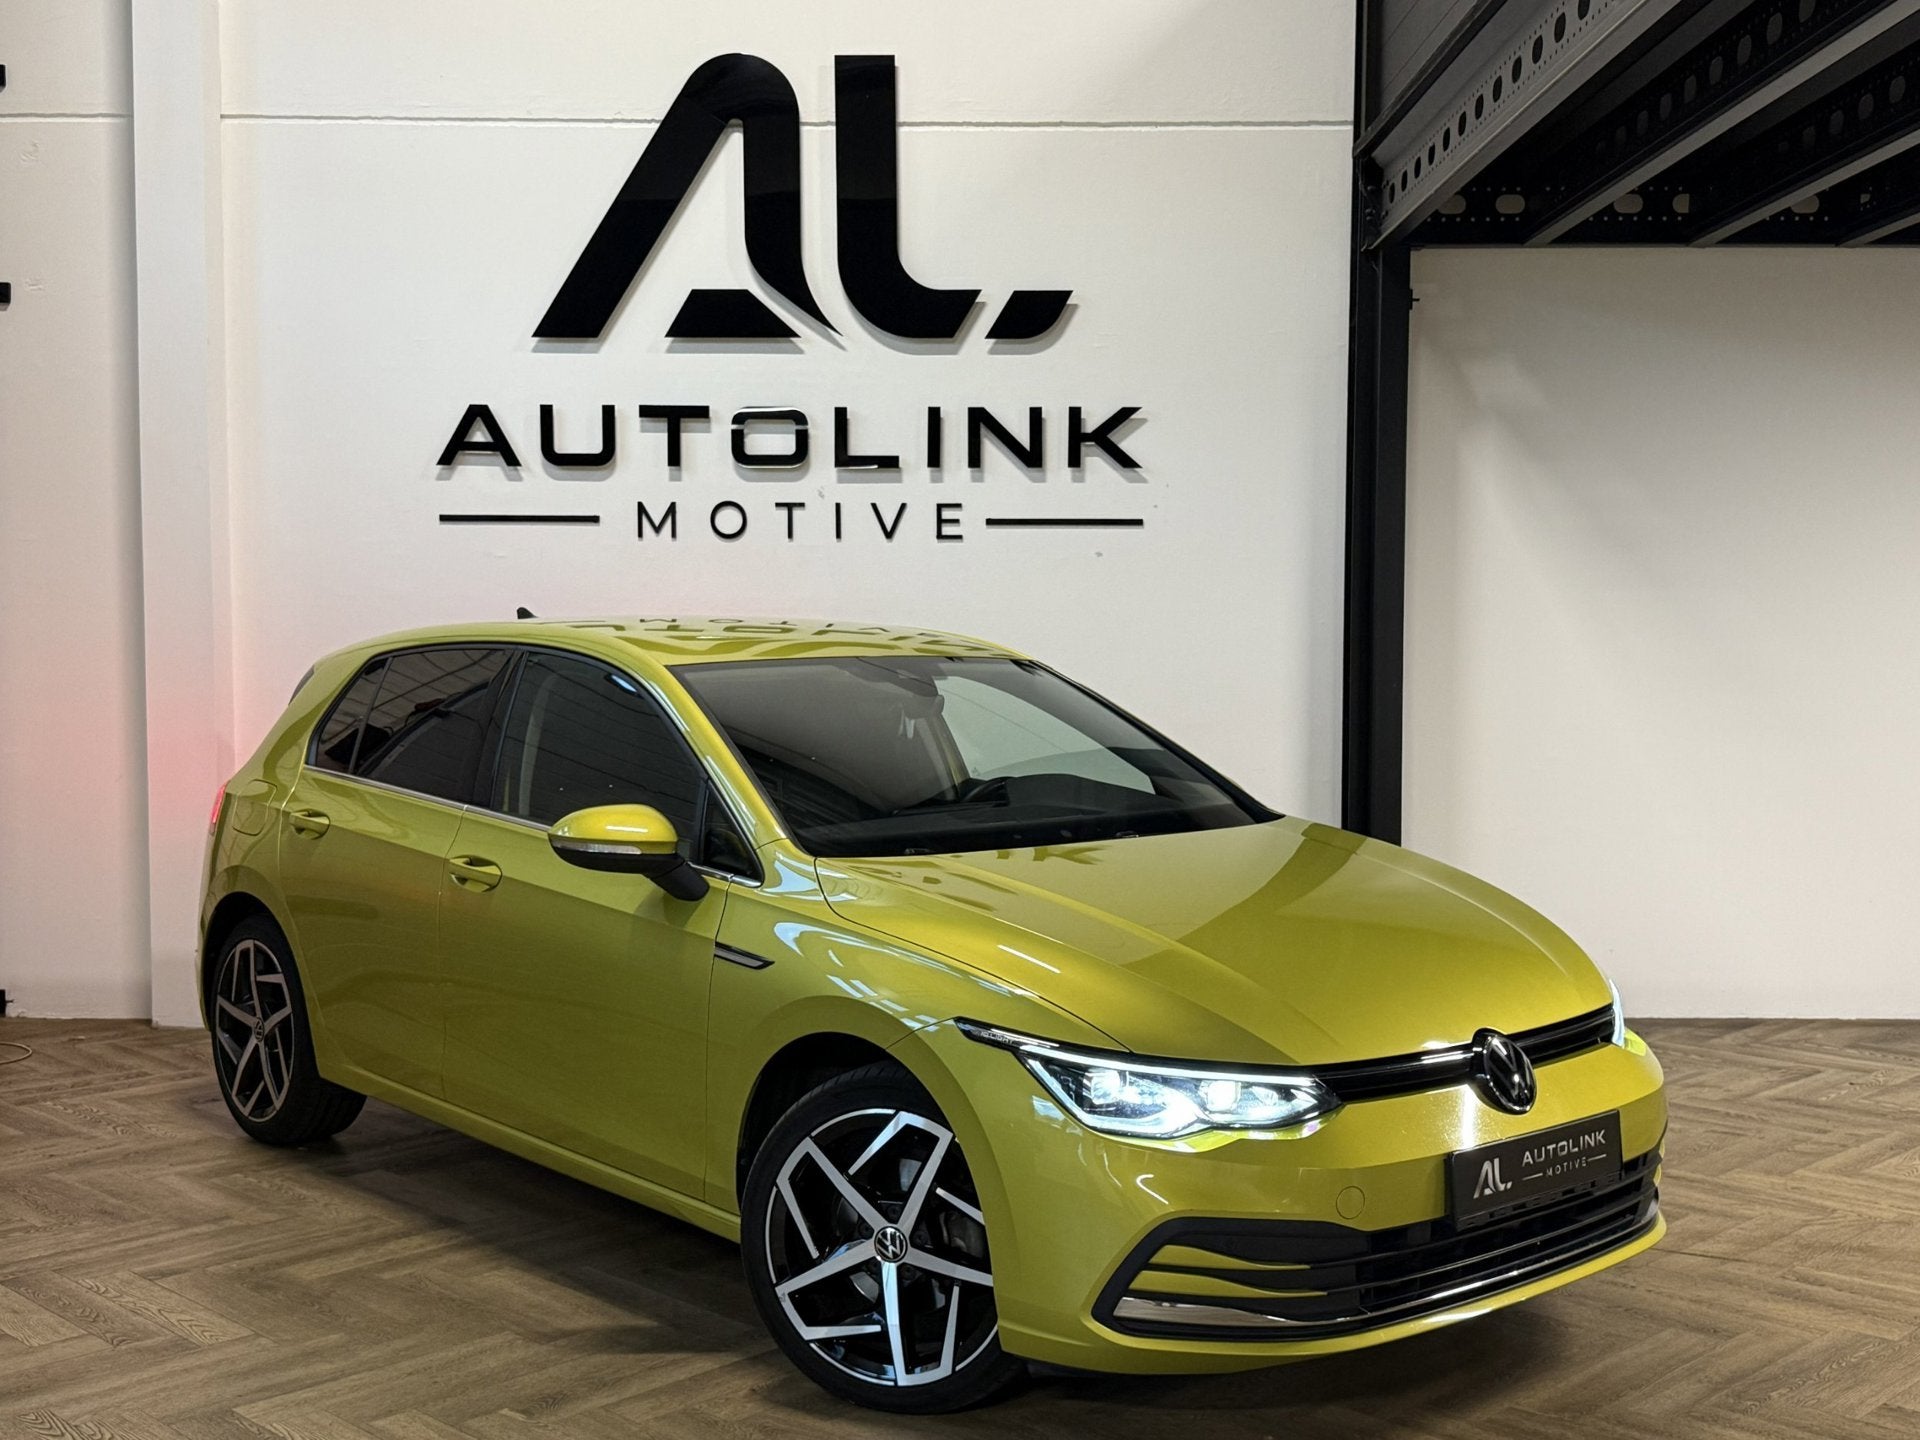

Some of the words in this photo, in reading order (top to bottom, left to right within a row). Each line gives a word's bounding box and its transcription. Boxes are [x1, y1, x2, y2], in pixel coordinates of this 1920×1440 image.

[436, 403, 1144, 469] AUTOLINK
[636, 500, 964, 540] MOTIVE
[1521, 1129, 1606, 1168] AUTOLINK
[1545, 1156, 1588, 1178] MOTIVE
